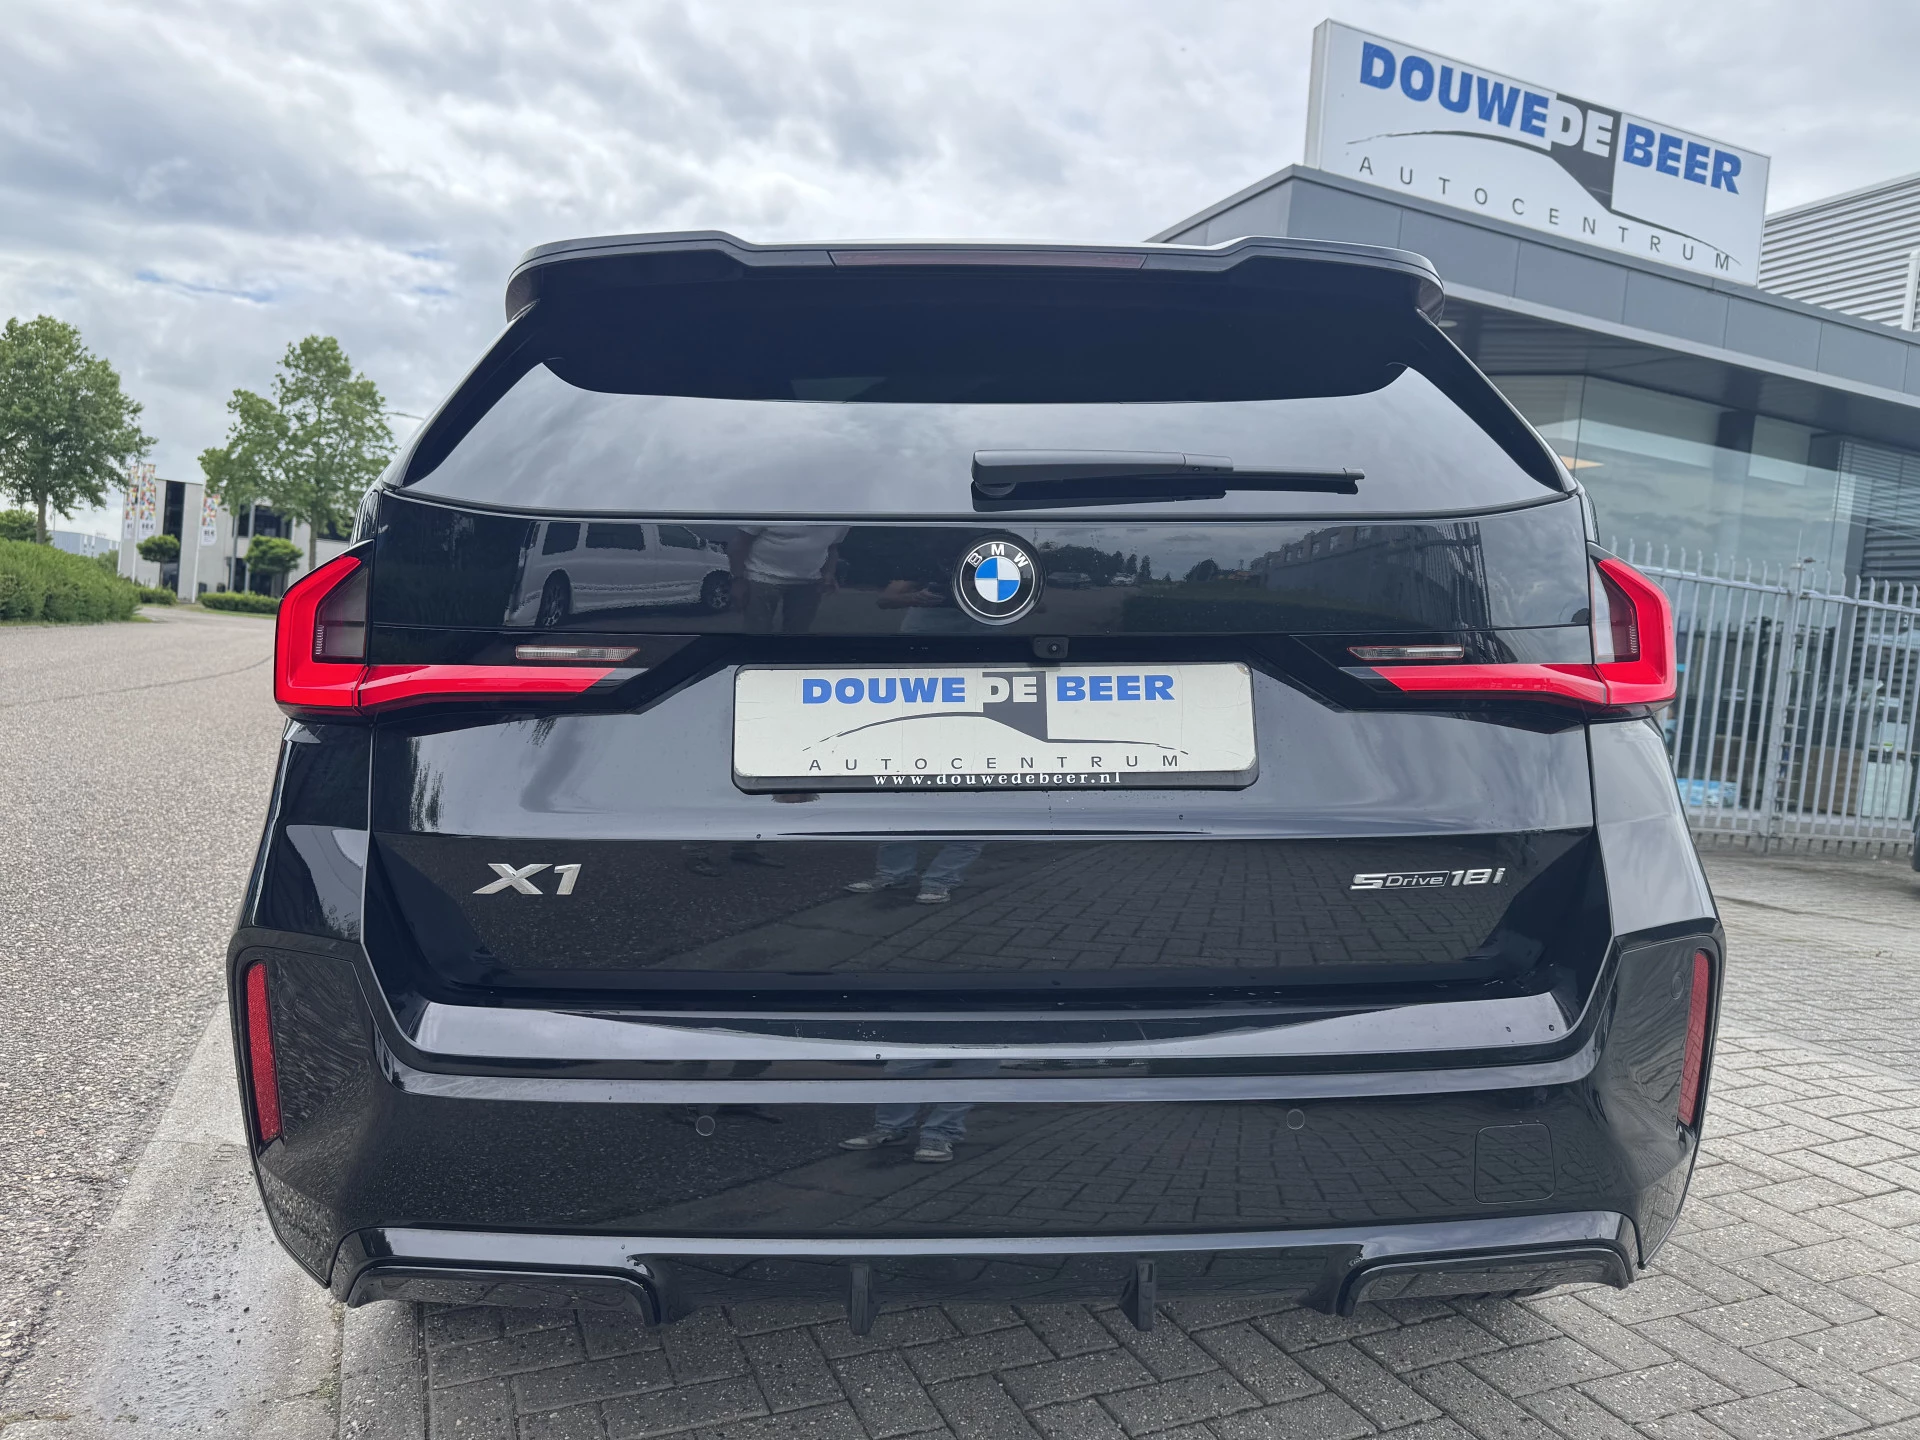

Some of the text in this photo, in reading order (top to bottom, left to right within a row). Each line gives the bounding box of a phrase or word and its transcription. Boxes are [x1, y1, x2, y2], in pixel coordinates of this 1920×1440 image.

[1359, 41, 1743, 195] DOUWE DE BEER
[1358, 156, 1731, 272] AUTOCENTRUM
[967, 544, 1029, 568] BMW
[802, 674, 1176, 704] DOUWE DE BEER
[808, 754, 1179, 772] AUTOCENTRUM
[873, 772, 1121, 785] www.douwedebeer.nl
[472, 863, 582, 895] X1
